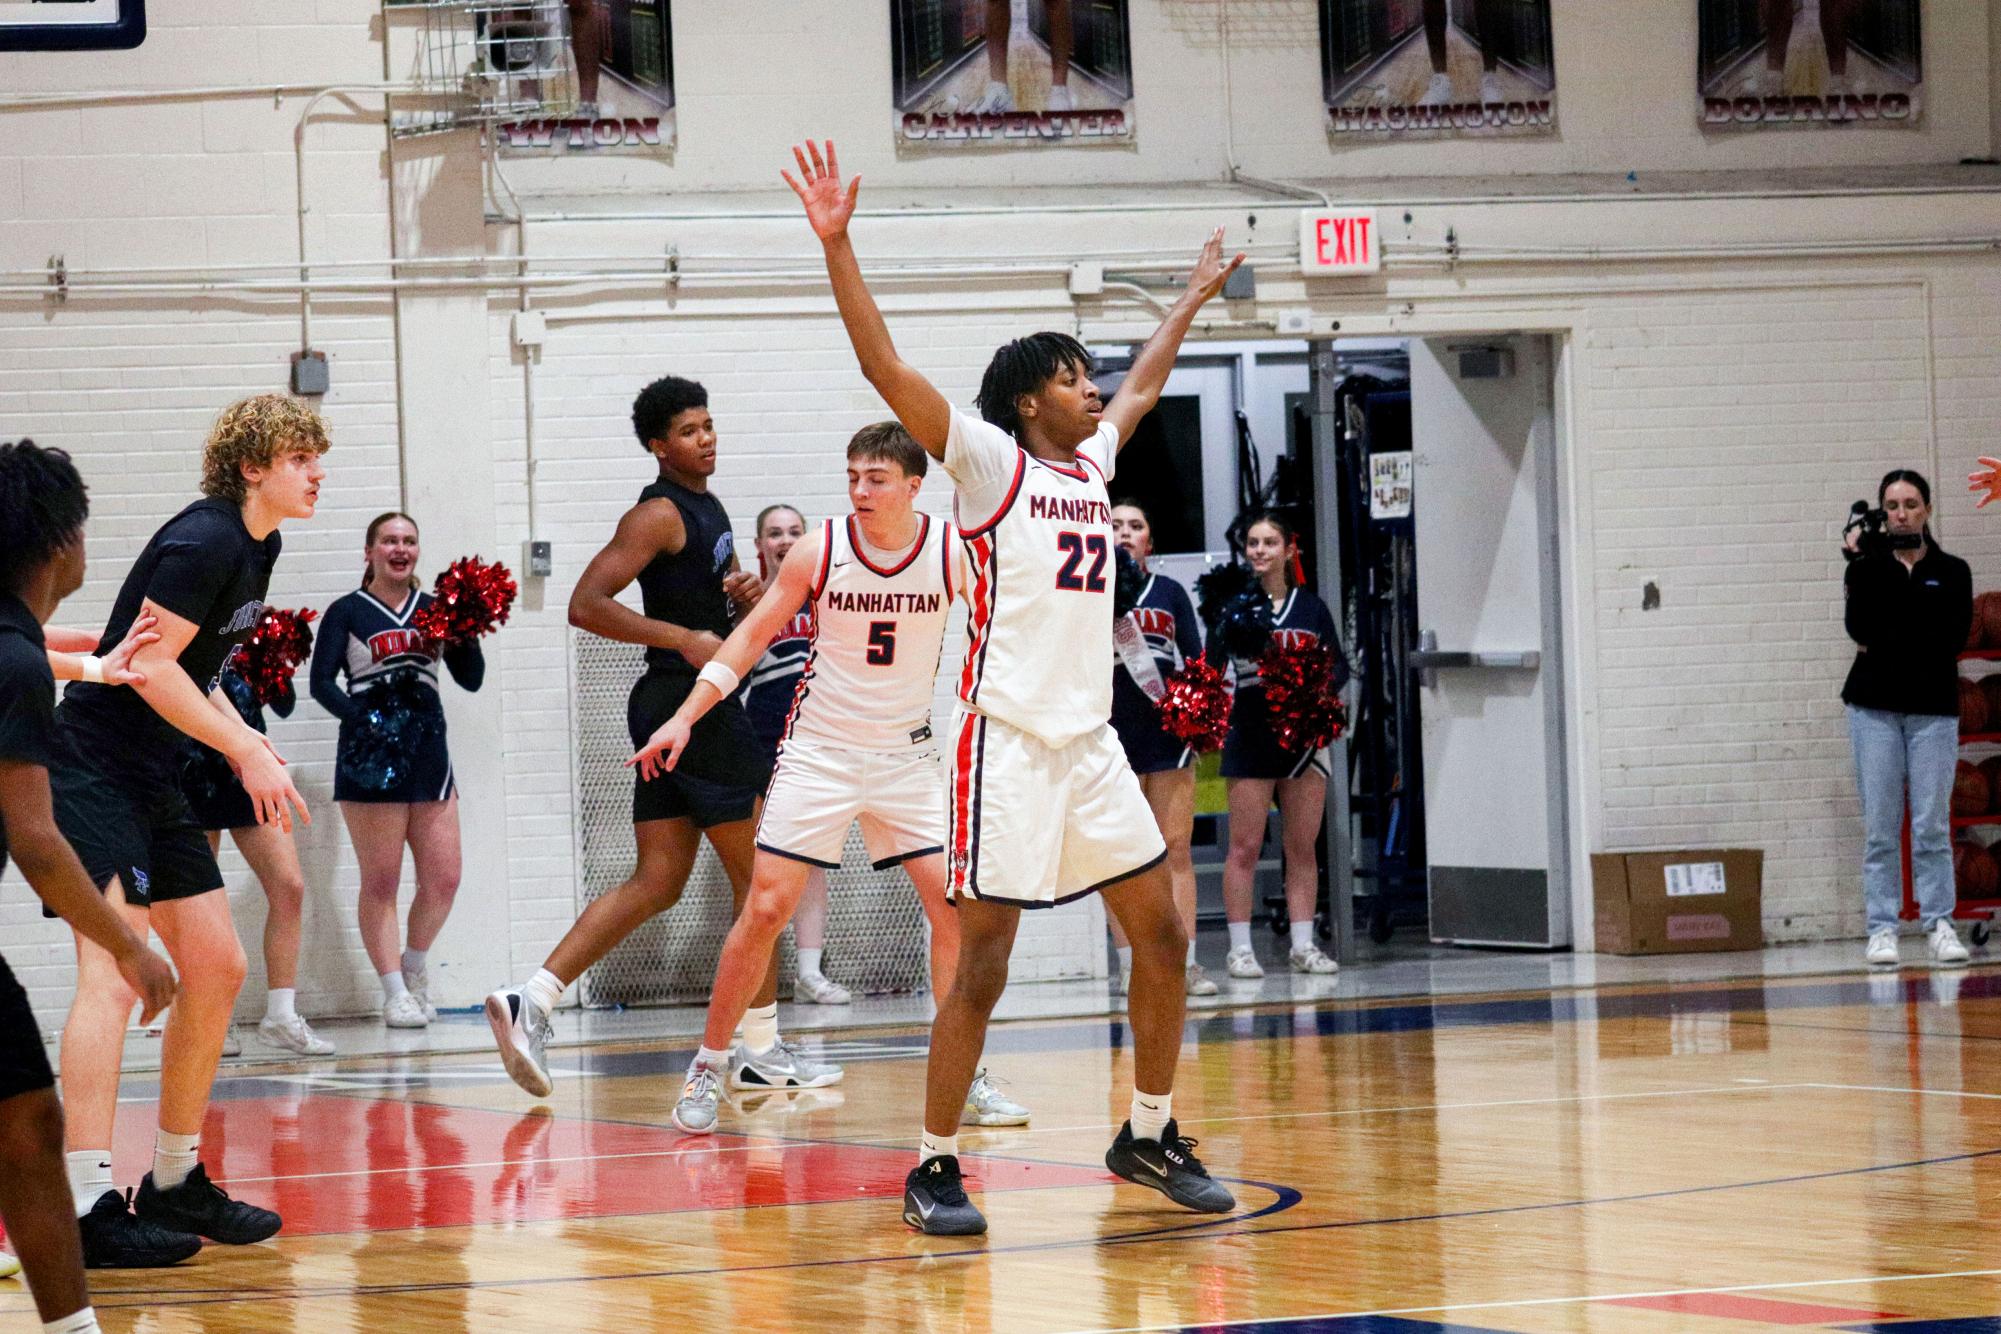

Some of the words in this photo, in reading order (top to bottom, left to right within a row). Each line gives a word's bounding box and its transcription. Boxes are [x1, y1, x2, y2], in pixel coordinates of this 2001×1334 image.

[1328, 101, 1550, 132] WASHINGTON
[1704, 93, 1911, 123] DOERING
[480, 118, 660, 147] WTON
[902, 109, 1128, 140] CARPENTER
[1316, 218, 1371, 265] EXIT
[1055, 531, 1108, 594] 22
[828, 591, 940, 614] MANHATTAN
[866, 621, 897, 667] 5
